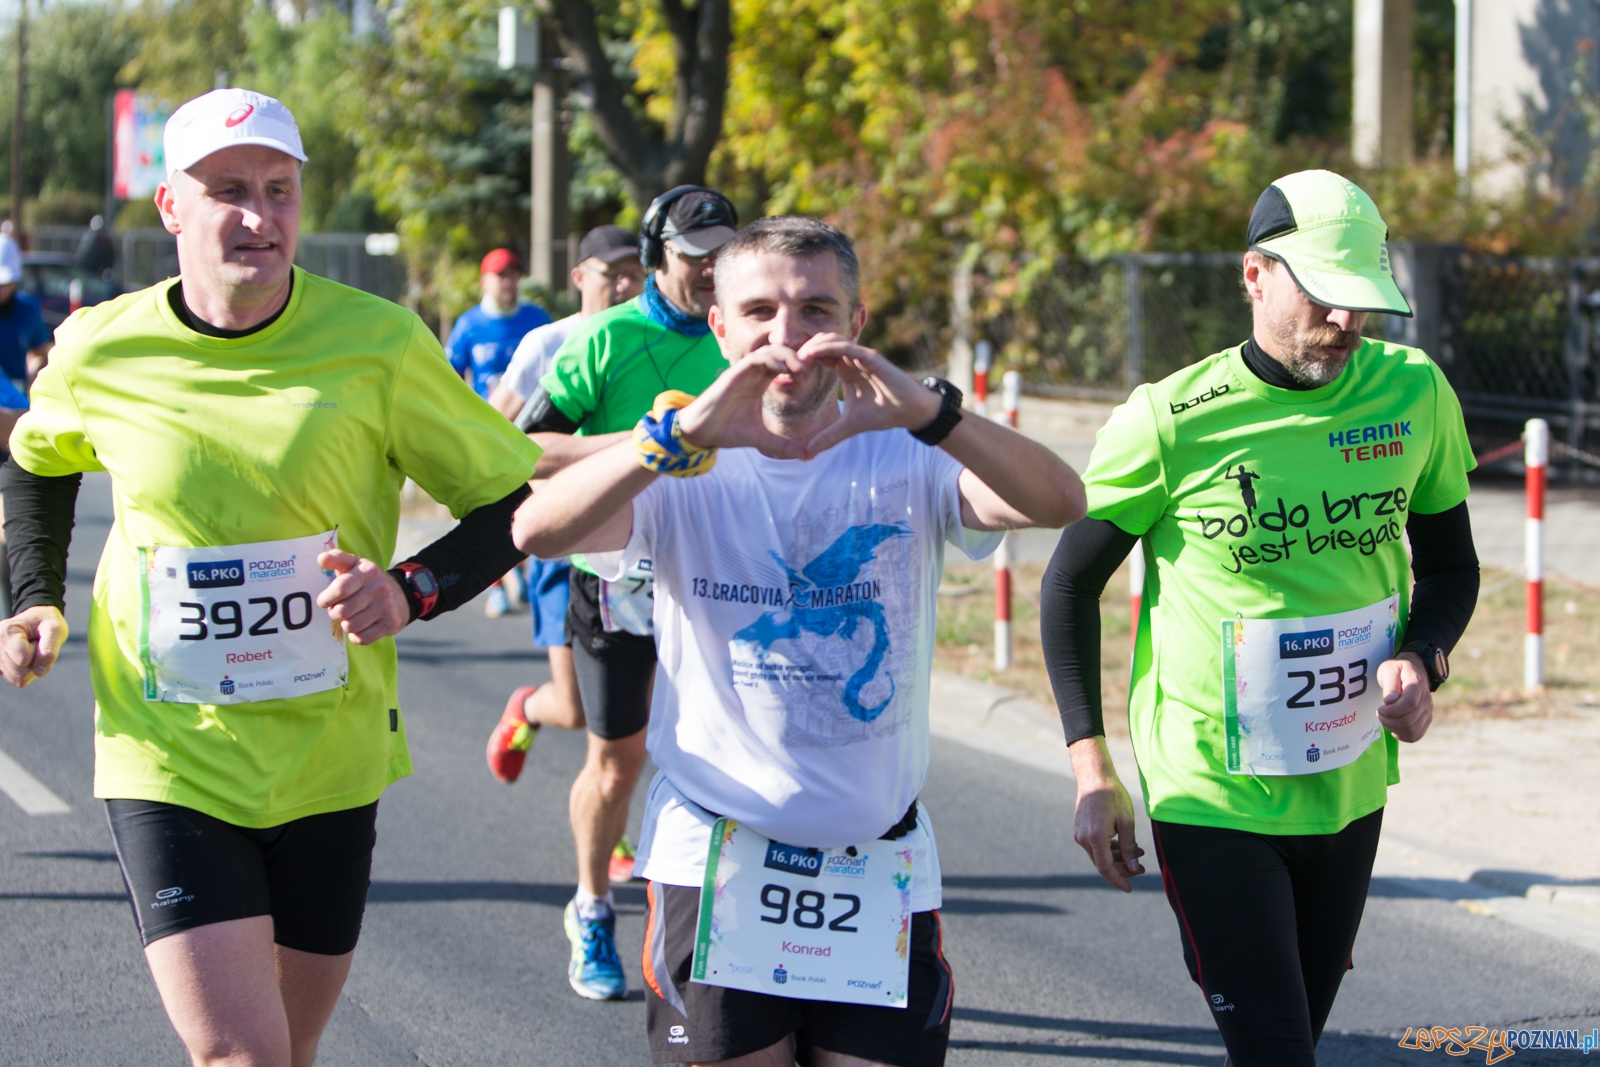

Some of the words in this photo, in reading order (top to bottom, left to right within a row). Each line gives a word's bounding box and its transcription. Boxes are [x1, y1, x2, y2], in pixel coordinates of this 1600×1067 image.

[1169, 383, 1230, 415] bodo
[1328, 420, 1412, 448] HERNIK
[1340, 440, 1404, 463] TEAM
[1220, 532, 1297, 574] jest
[1306, 517, 1401, 556] biegać
[211, 567, 240, 581] PKO
[249, 567, 295, 580] maraton
[810, 579, 881, 609] MARATON
[179, 591, 313, 641] 3920
[1304, 636, 1330, 650] PKO
[1338, 631, 1372, 647] maraton
[226, 649, 273, 664] Robert
[238, 681, 254, 689] Bank
[256, 679, 273, 688] Polski
[1286, 658, 1368, 709] 233
[1305, 711, 1357, 733] Krzysztof
[1323, 748, 1336, 756] Bank
[1337, 744, 1350, 753] Polski
[789, 853, 818, 869] PKO
[823, 865, 866, 875] maraton
[760, 883, 861, 933] 982
[782, 941, 832, 957] Konrad
[791, 974, 806, 982] Bank
[808, 976, 826, 984] Polski
